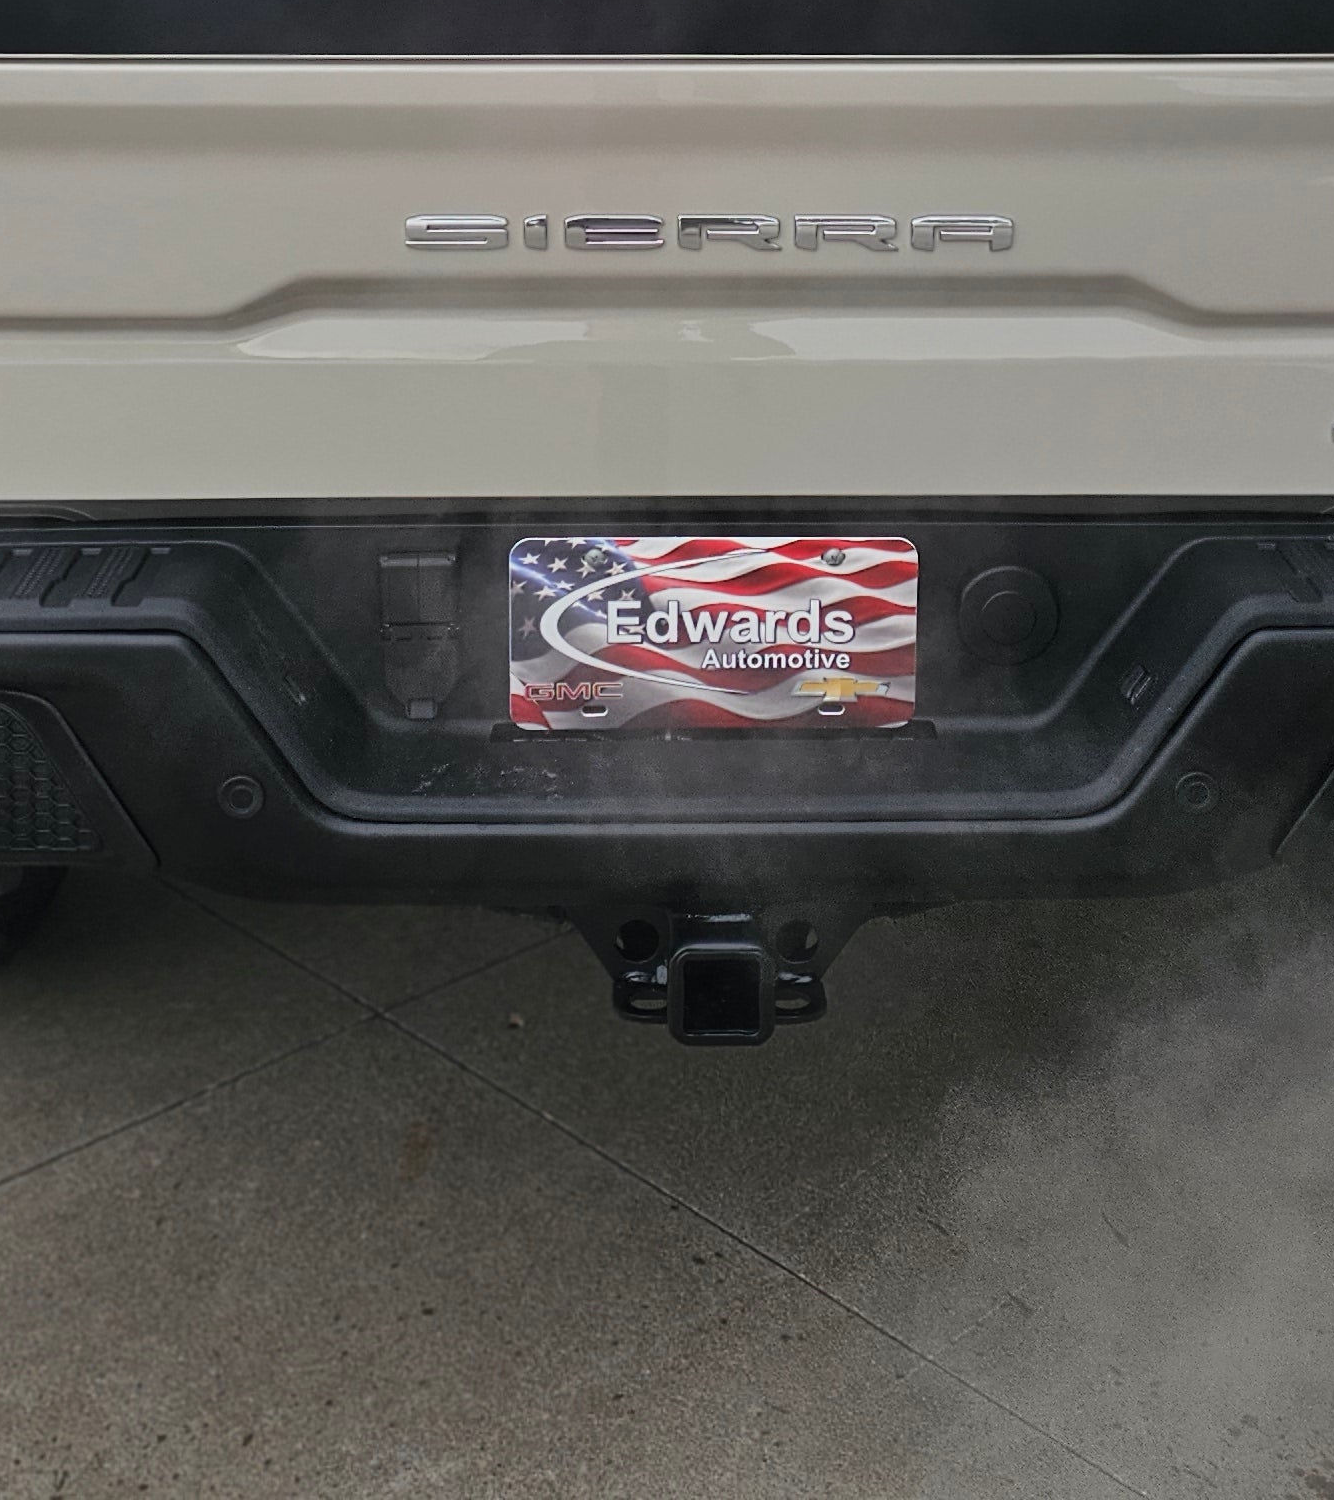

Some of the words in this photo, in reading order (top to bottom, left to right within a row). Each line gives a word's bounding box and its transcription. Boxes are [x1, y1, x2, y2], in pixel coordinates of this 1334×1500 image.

[405, 214, 1014, 252] SIERRA
[606, 599, 855, 645] Edwards
[701, 649, 851, 670] Automotive
[524, 681, 624, 701] GMC
